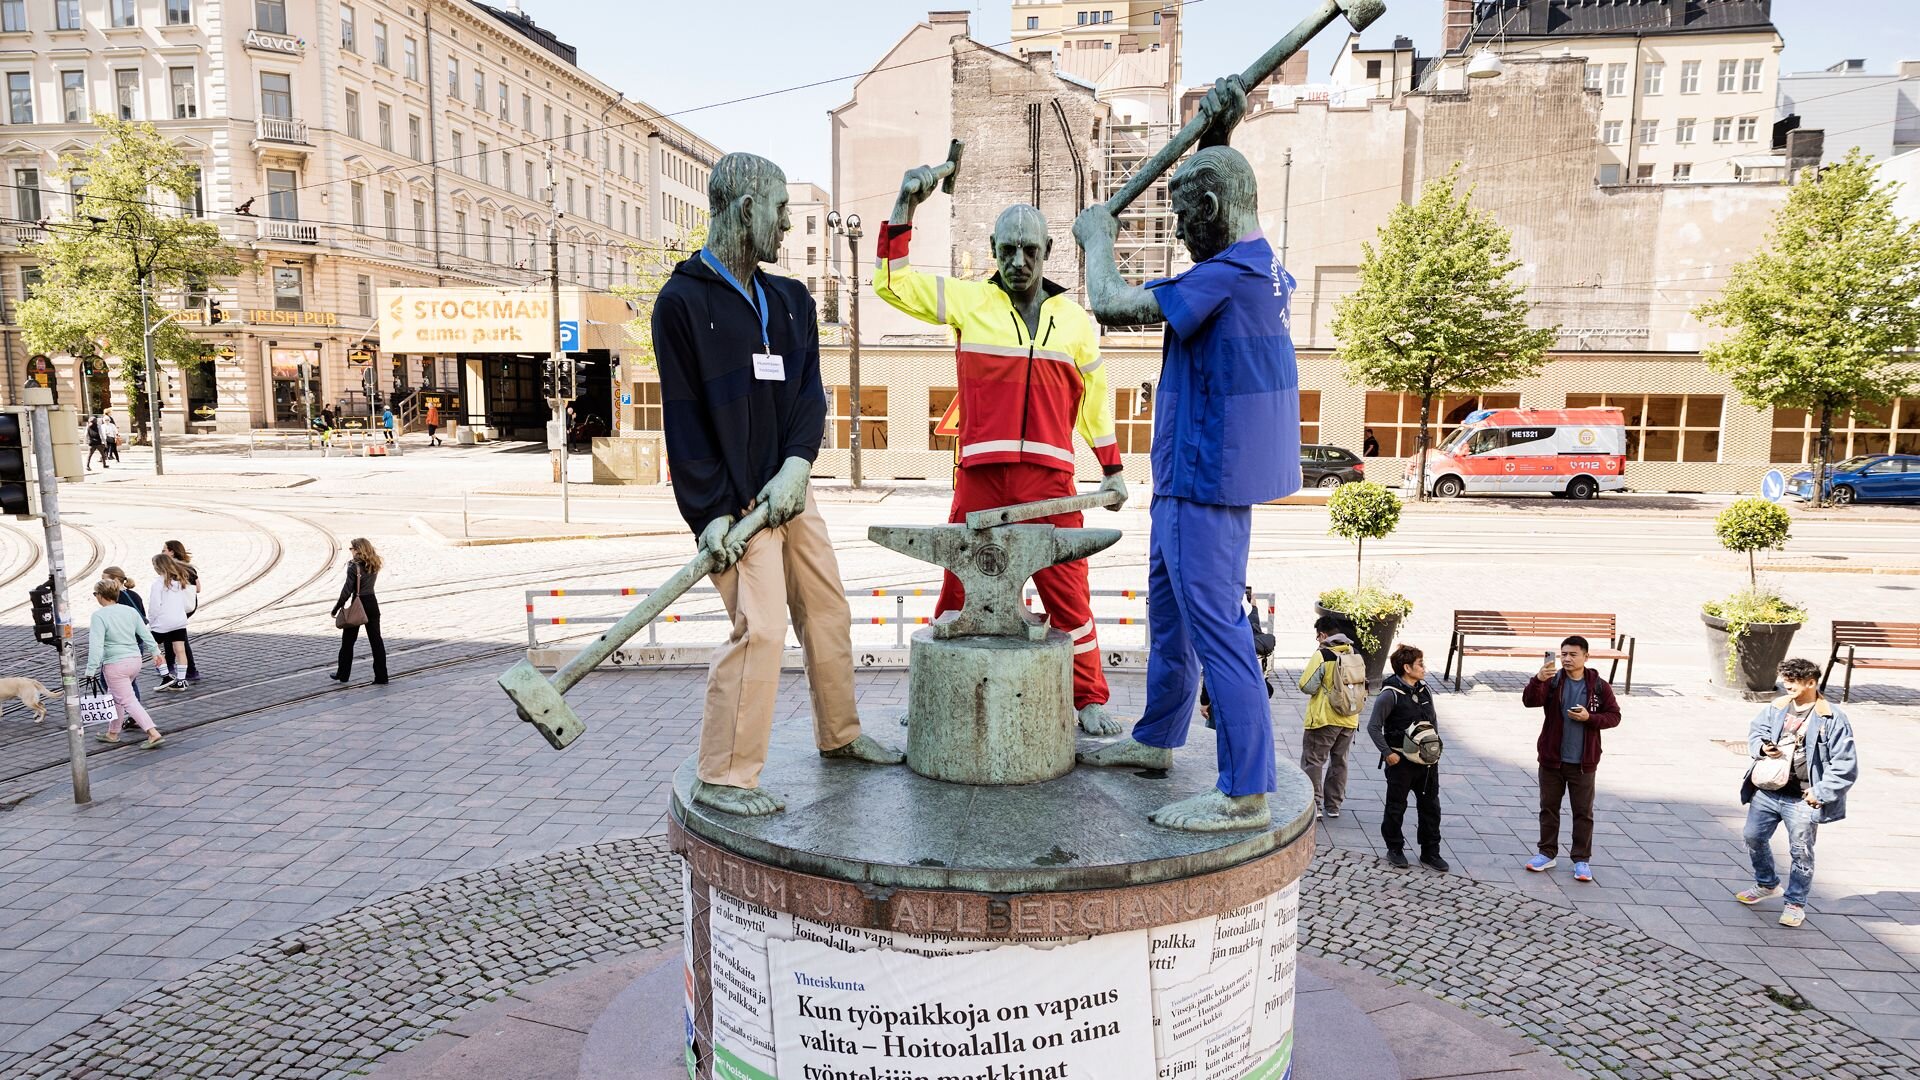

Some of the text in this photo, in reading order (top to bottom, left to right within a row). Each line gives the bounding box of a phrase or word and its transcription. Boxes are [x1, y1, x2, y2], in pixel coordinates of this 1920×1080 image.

[245, 30, 297, 51] Aava
[250, 310, 337, 325] IRISH PUB
[414, 300, 549, 319] STOCKMAN
[472, 326, 523, 344] park
[1578, 461, 1600, 469] 112
[81, 711, 113, 722] ekko
[747, 900, 778, 919] palkka
[1254, 901, 1264, 912] on
[723, 908, 734, 922] ole
[735, 914, 766, 933] myytti!
[844, 926, 861, 938] on
[1152, 933, 1196, 954] palkka
[718, 949, 756, 982] arvokkaita
[724, 971, 758, 998] elämästä
[757, 992, 767, 1004] ja
[794, 971, 866, 992] Yhteiskunta
[728, 990, 760, 1017] palkkaa.
[797, 988, 1119, 1032] Kun työpaikkoja on vapaus
[1171, 1004, 1197, 1018] Vitsejä,
[800, 1030, 859, 1055] valita
[882, 1031, 1027, 1058] Hoitoalalla
[1032, 1032, 1065, 1050] on
[1070, 1020, 1121, 1044] aina
[1205, 1043, 1221, 1058] Tule
[803, 1060, 1069, 1080] työntekijän markkinat
[1159, 1059, 1198, 1080] ei jäm
[1205, 1058, 1221, 1071] kuin
[1221, 1051, 1234, 1063] olet
